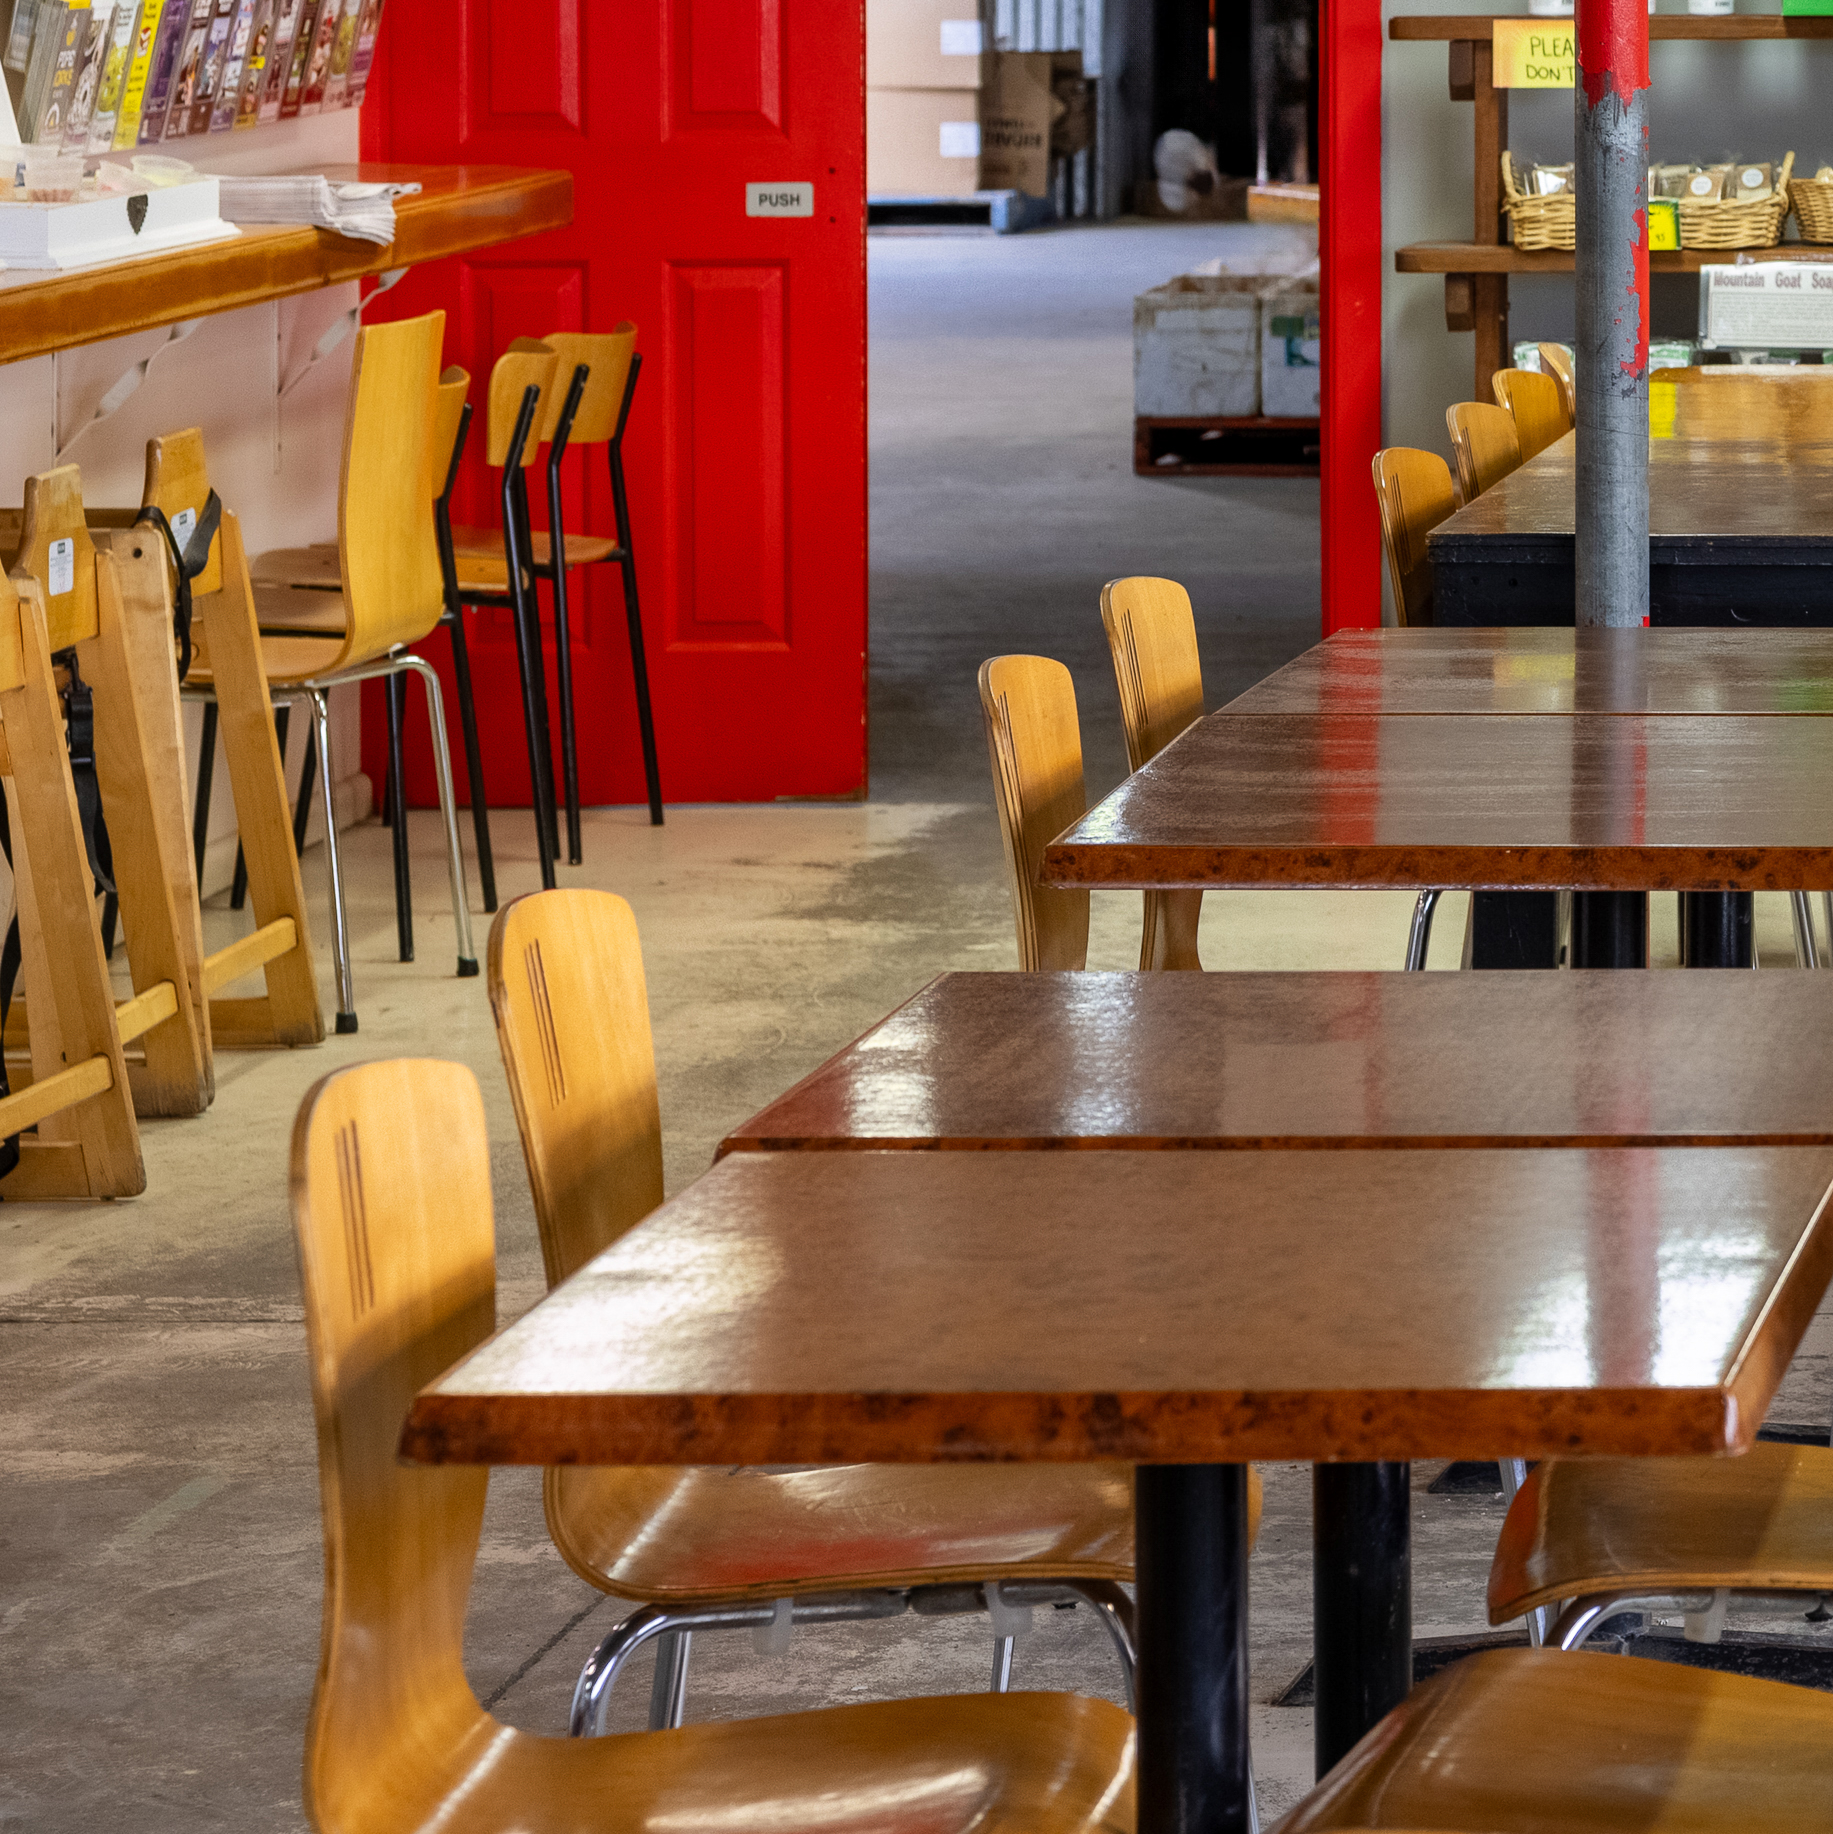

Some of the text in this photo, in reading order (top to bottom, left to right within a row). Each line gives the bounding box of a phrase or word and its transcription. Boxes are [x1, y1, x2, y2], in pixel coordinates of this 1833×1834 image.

[1530, 36, 1575, 58] PLEA
[758, 193, 801, 207] PUSH
[1713, 270, 1765, 289] Mountain
[1775, 270, 1802, 289] Goat
